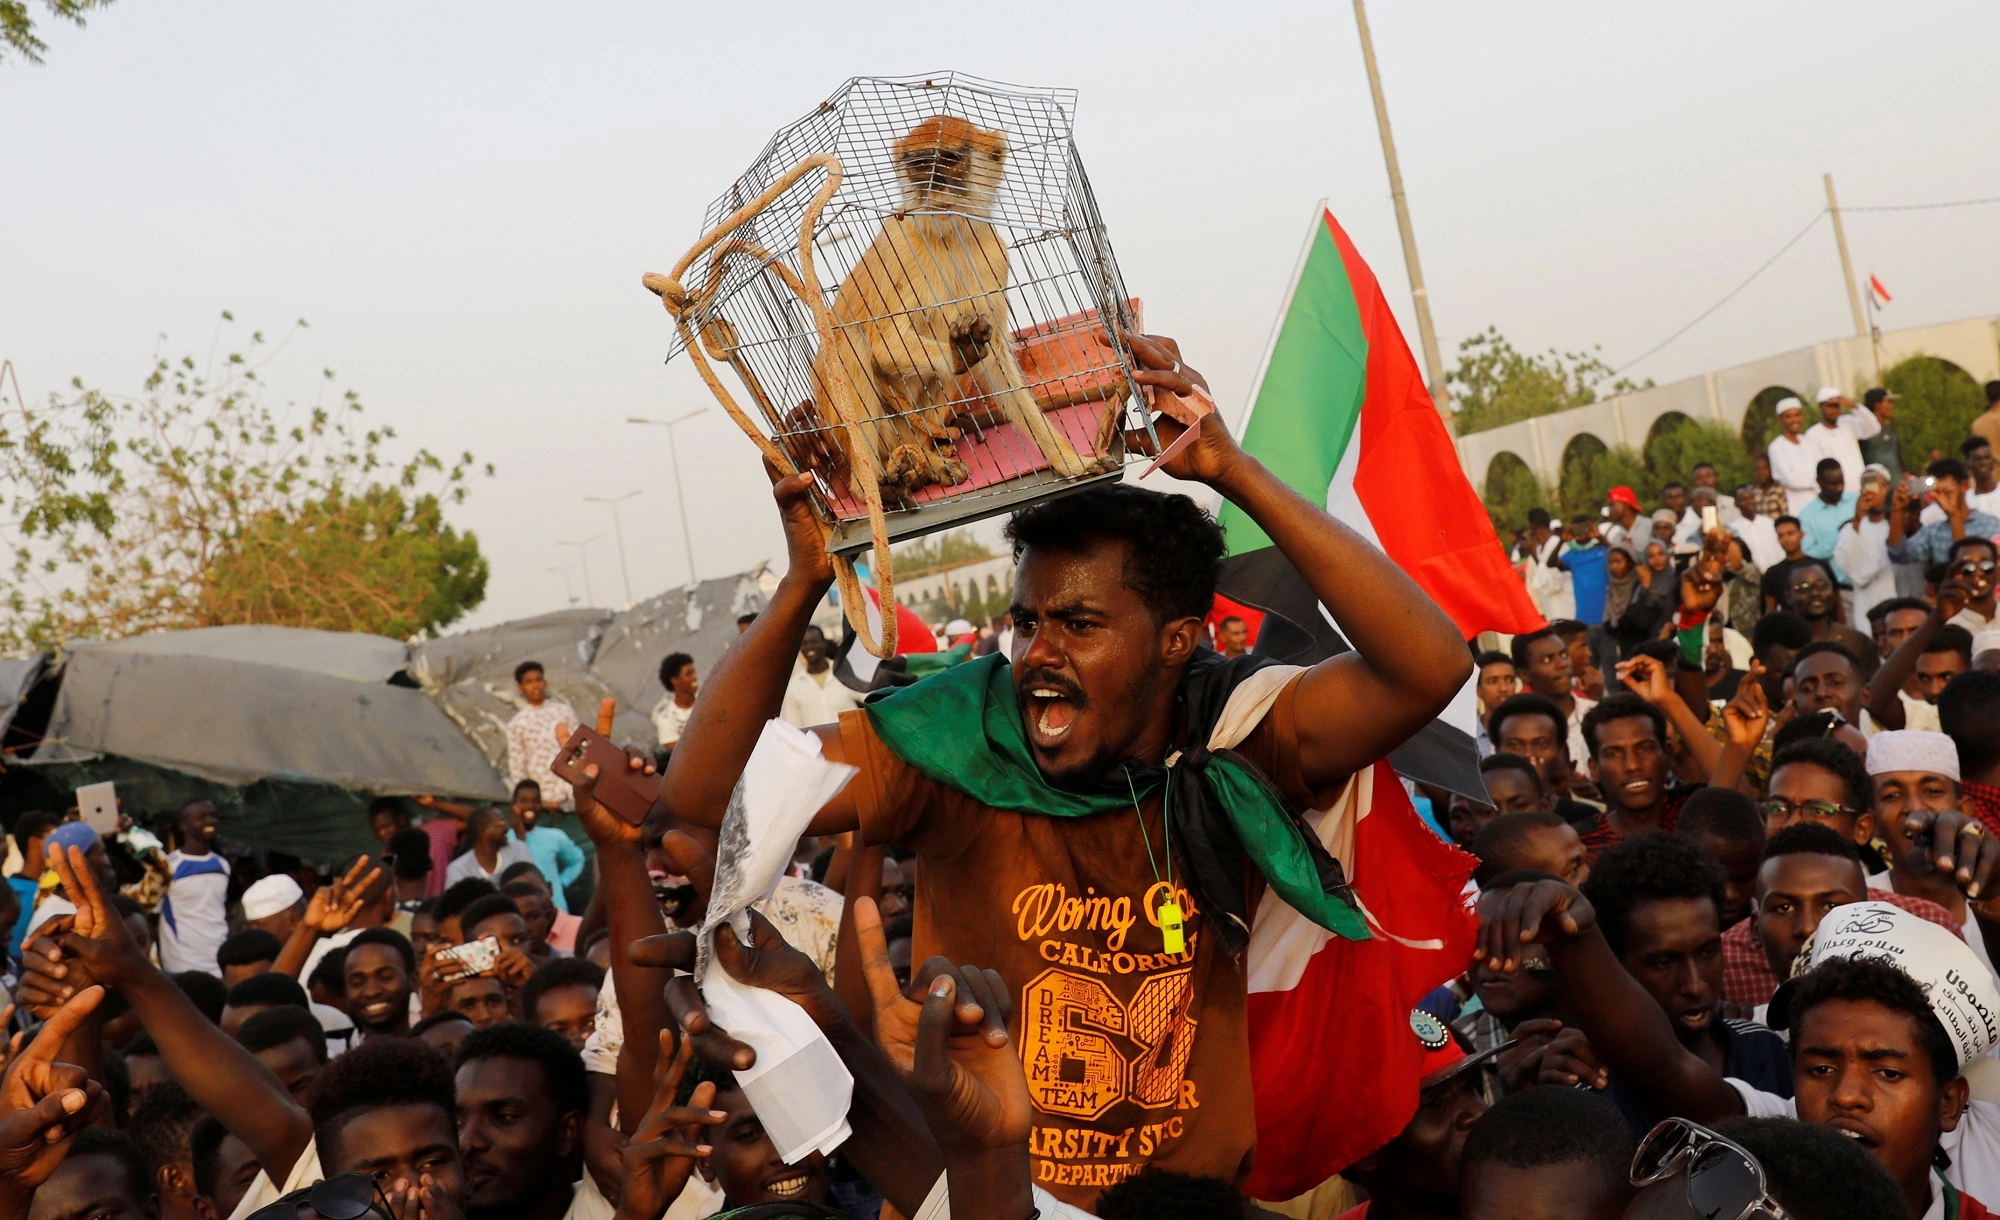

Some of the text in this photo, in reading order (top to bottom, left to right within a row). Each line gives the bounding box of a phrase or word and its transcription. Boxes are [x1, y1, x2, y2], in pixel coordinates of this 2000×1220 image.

[1862, 939, 1905, 955] سلام
[1945, 969, 1998, 1044] معتصمون
[1031, 988, 1054, 1082] DREAM
[1039, 1087, 1098, 1110] TEAM
[1029, 1126, 1135, 1159] ARSITY
